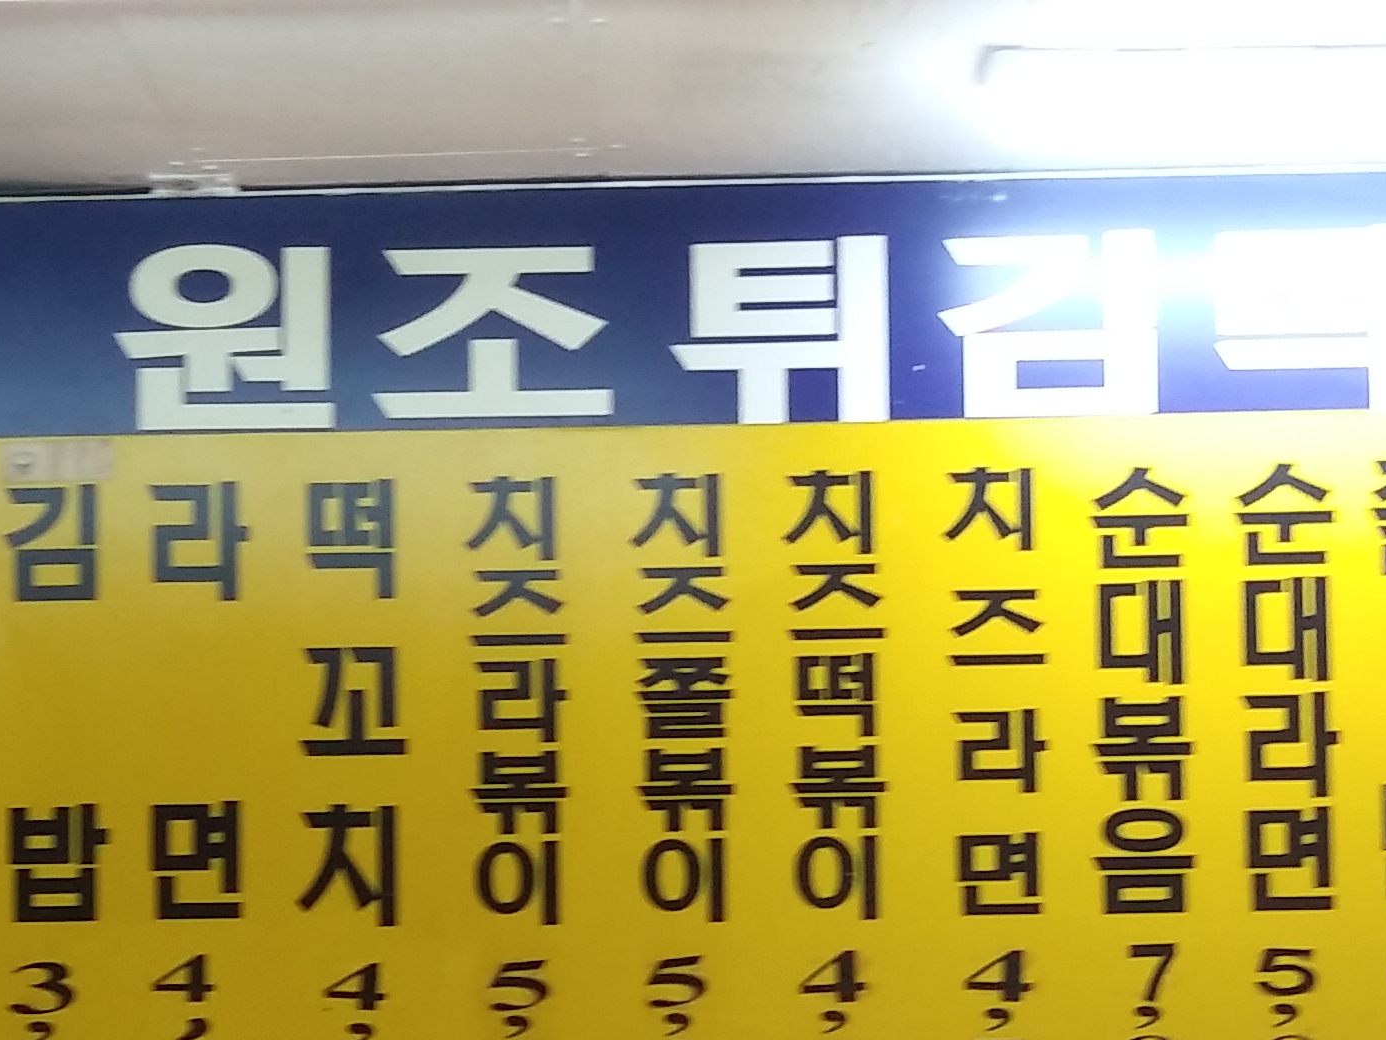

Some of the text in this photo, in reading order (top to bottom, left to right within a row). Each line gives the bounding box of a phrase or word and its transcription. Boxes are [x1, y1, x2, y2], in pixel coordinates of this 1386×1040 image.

[113, 243, 614, 431] 원조
[295, 478, 408, 927] 떡꼬치
[465, 476, 568, 925] 치즈라볶이
[630, 472, 734, 923] 치즈쫄볶이
[784, 469, 887, 921] 치즈떡볶이
[943, 466, 1050, 916] 치즈라면
[1090, 466, 1196, 915] 순대볶음
[1235, 463, 1342, 911] 순대라면
